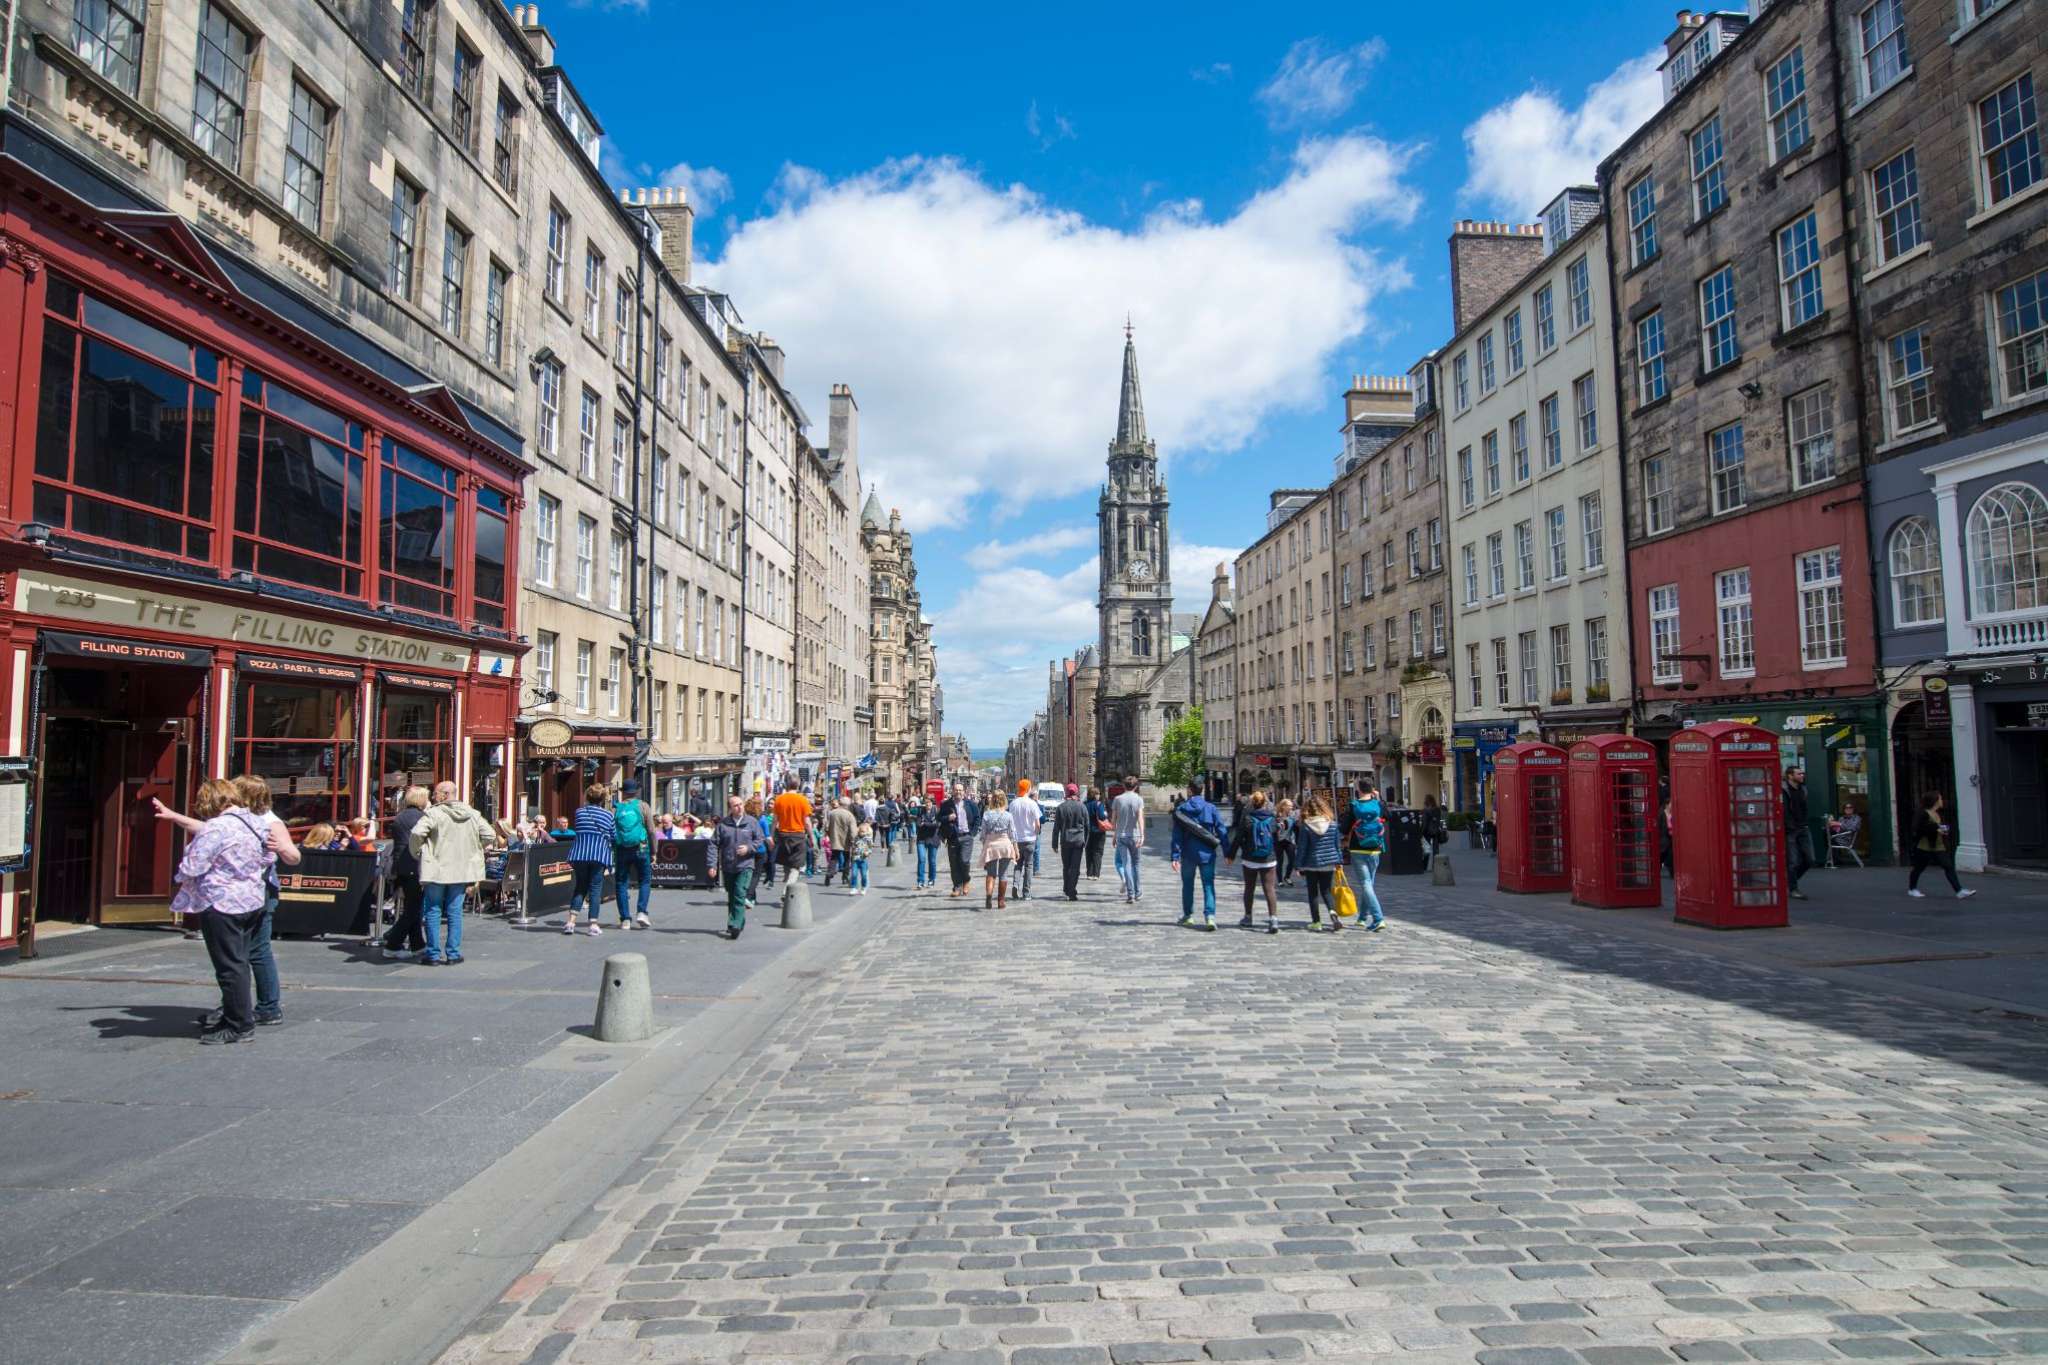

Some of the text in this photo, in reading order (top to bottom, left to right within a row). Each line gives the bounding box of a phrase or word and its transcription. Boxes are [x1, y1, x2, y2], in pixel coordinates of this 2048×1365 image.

[135, 598, 201, 628] THE
[231, 612, 335, 648] FILLING
[355, 634, 430, 662] STATION
[80, 640, 185, 660] FILLING STATION
[249, 660, 356, 678] PIZZA PASTA BURGERS
[302, 878, 345, 888] STATION
